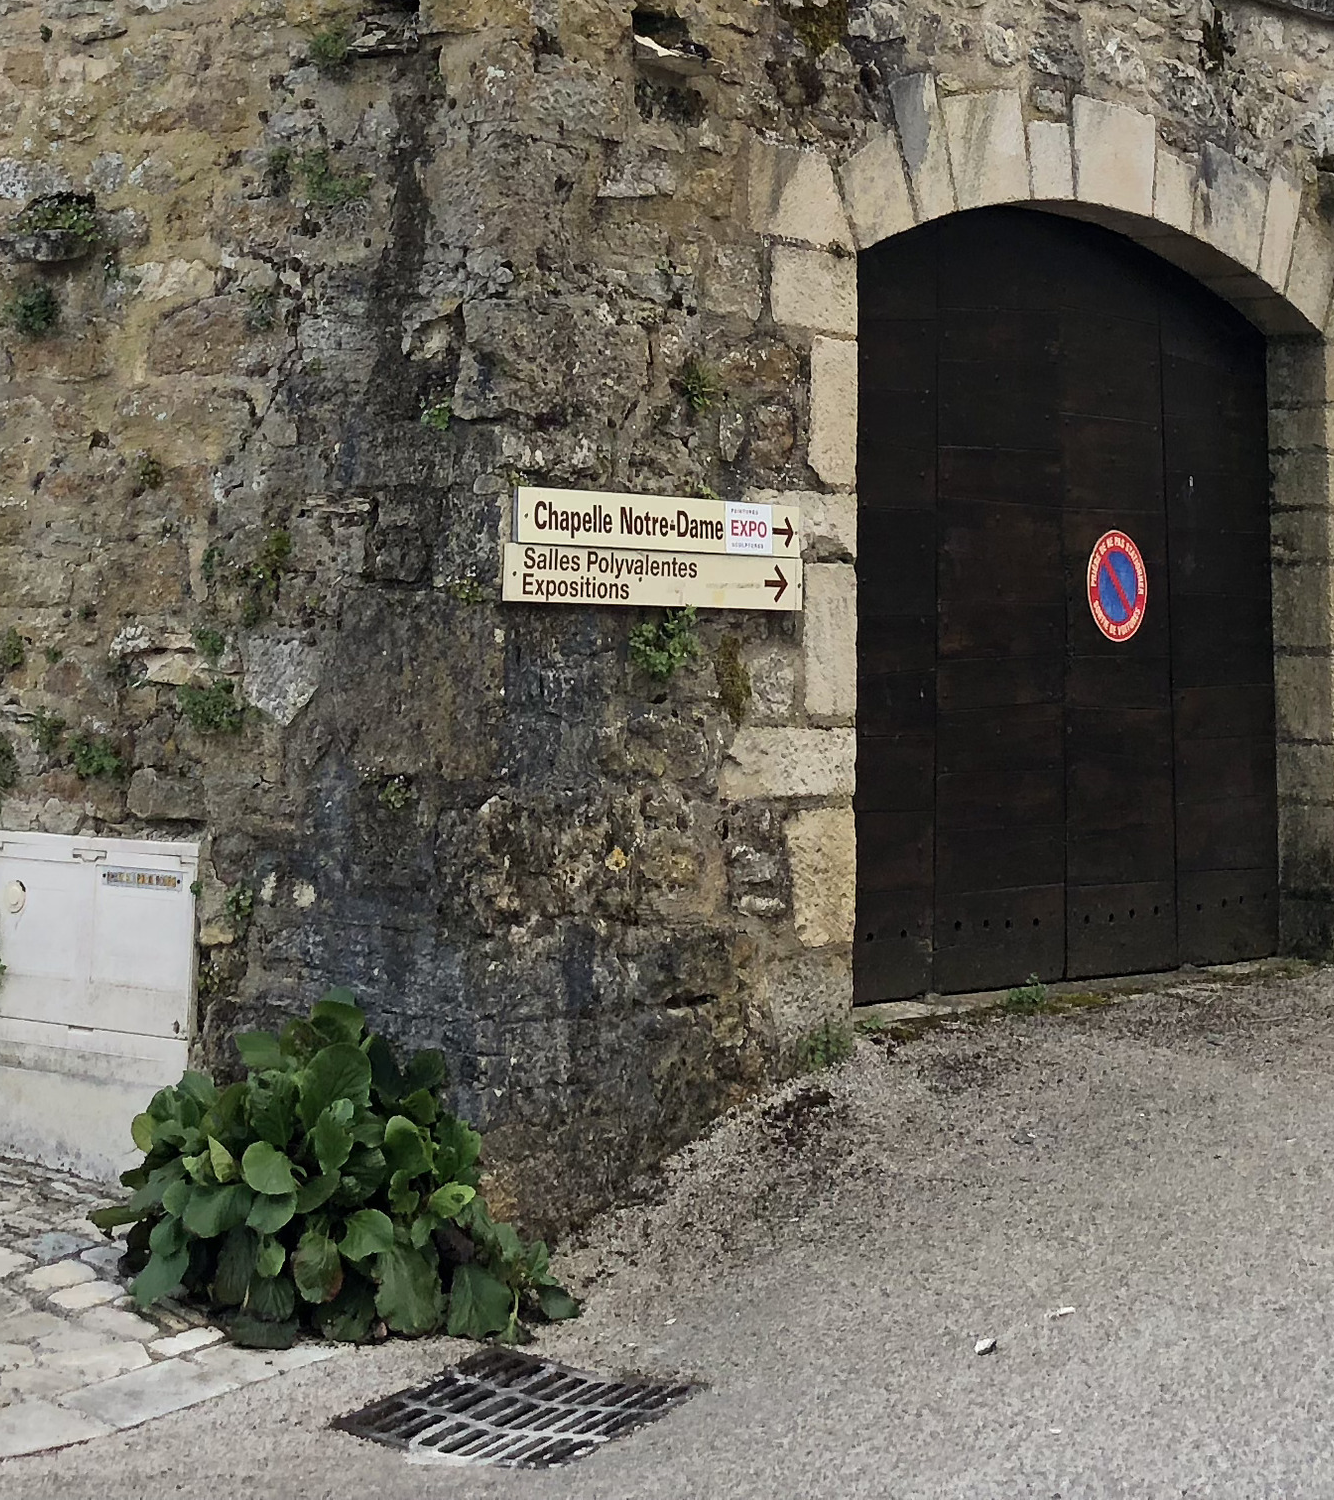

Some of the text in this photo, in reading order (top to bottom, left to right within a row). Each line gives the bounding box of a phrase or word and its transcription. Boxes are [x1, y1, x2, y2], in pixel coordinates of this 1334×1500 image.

[534, 500, 724, 541] Chapelle Notre-Dame
[731, 519, 768, 538] EXPO
[523, 547, 698, 579] Salles Polyvalentes
[521, 573, 630, 601] Expositions
